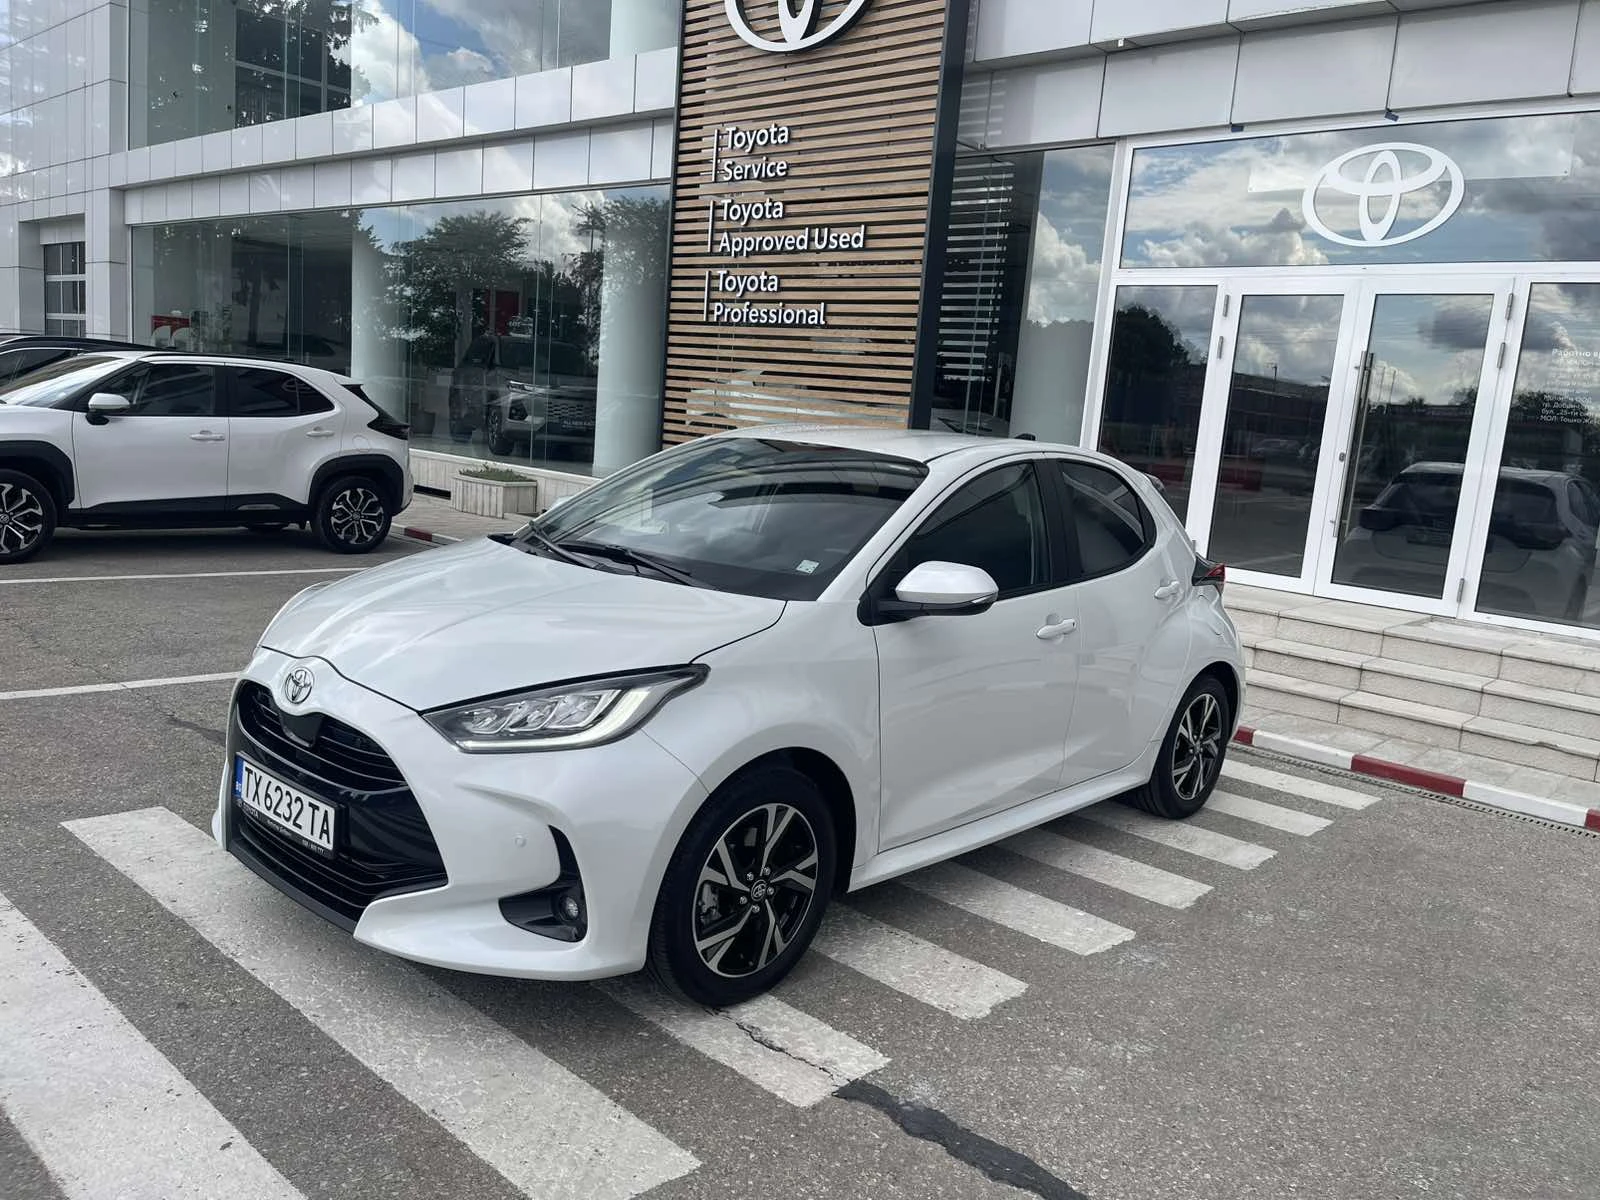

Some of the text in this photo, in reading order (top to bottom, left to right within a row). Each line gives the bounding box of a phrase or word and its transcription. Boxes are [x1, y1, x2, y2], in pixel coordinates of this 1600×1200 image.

[726, 123, 789, 153] Toyota
[723, 156, 788, 181] Service
[721, 198, 784, 225] Toyota
[719, 224, 865, 257] Approved Used
[716, 270, 779, 297] Toyota
[713, 302, 826, 325] Professional
[245, 766, 262, 806] TX
[264, 780, 303, 830] 6232
[308, 801, 331, 845] TA
